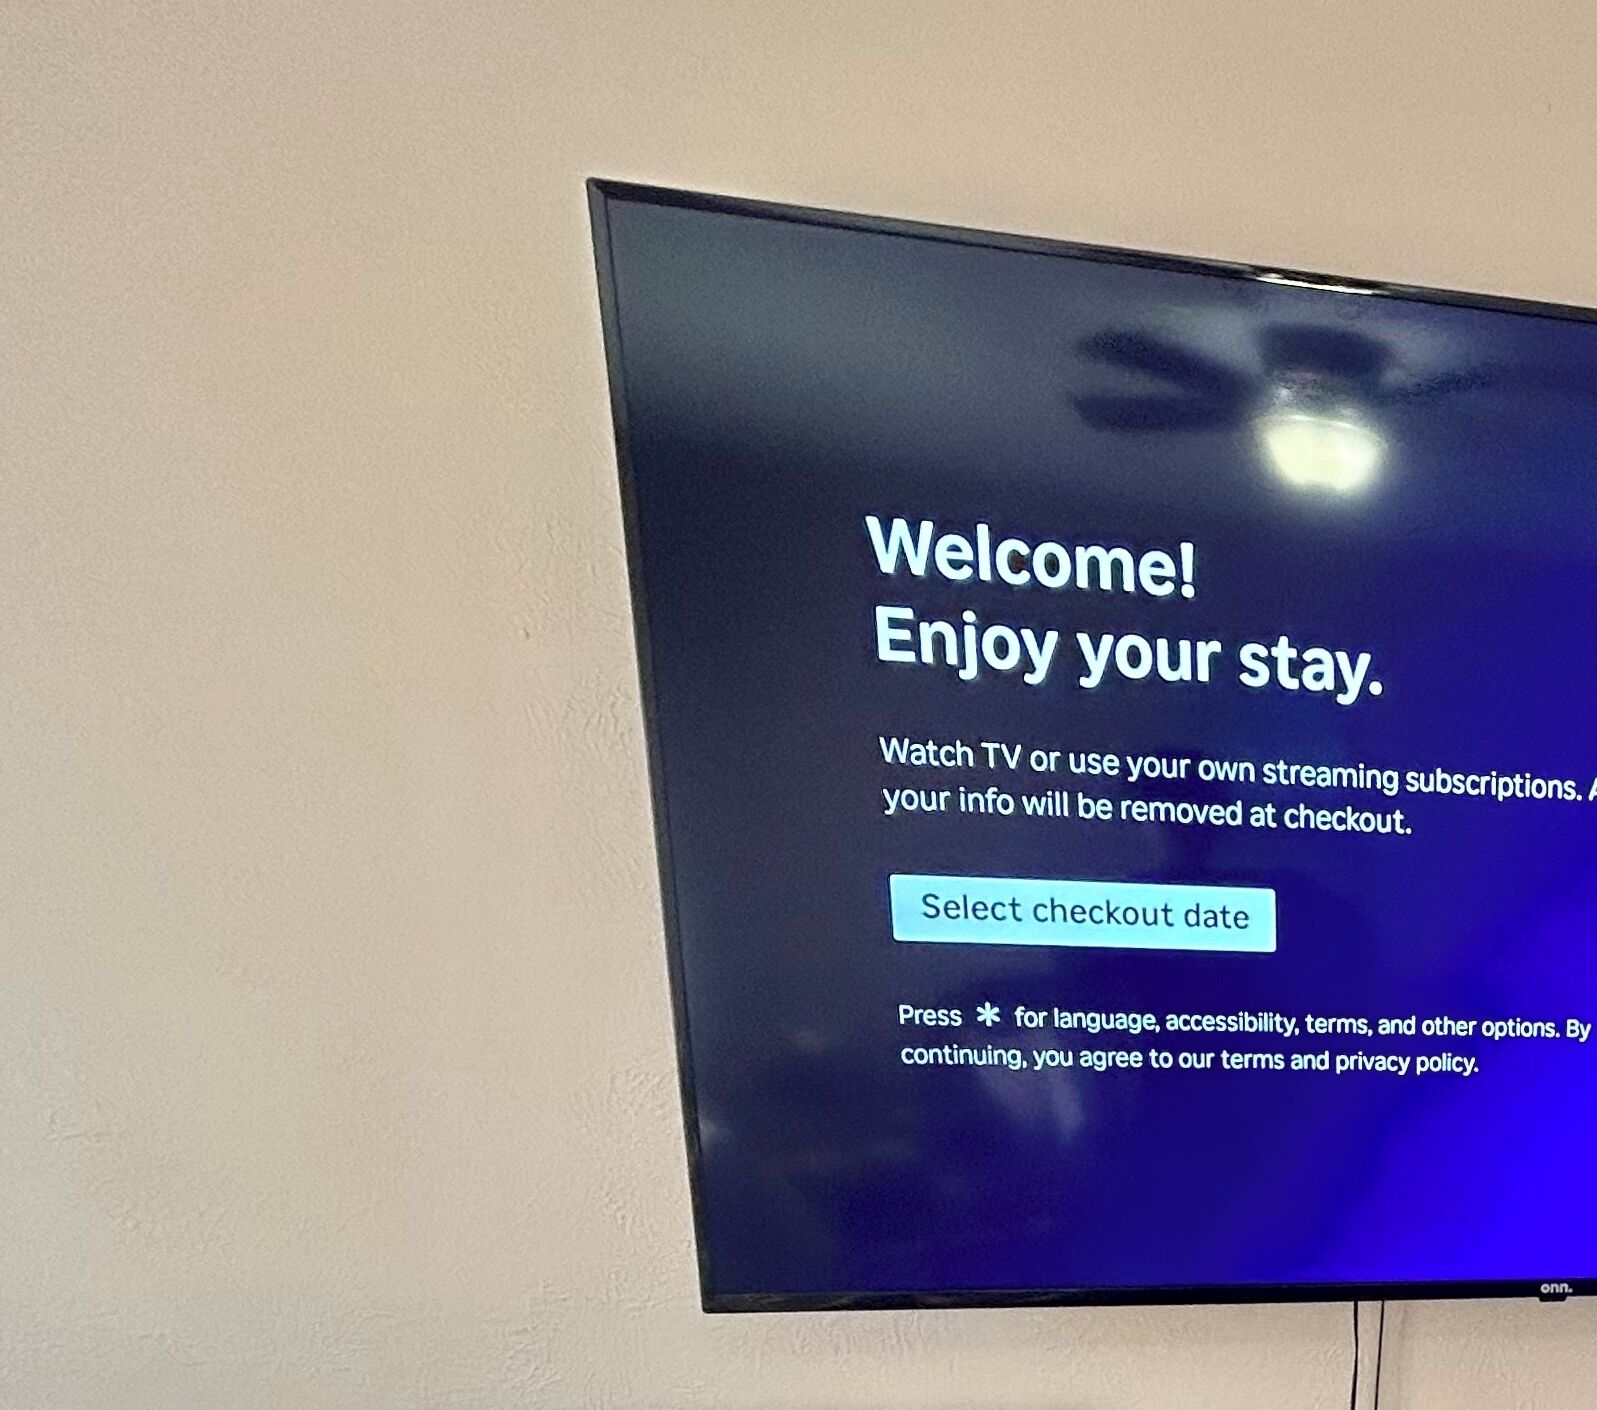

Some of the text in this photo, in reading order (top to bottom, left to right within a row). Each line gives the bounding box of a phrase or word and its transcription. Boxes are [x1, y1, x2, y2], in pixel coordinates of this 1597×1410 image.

[865, 514, 1199, 598] Welcome!
[874, 604, 1385, 707] Enjoy your stay.
[879, 737, 974, 771] Watch
[981, 743, 1022, 771] TV
[1029, 748, 1061, 774] or
[1069, 749, 1120, 777] use
[1127, 754, 1191, 784] your
[1199, 757, 1256, 783] own
[1263, 758, 1399, 796] streaming
[1405, 766, 1583, 803] subscriptions.
[882, 786, 1413, 835] your info will be removed at checkout.
[920, 892, 1251, 932] Select checkout date
[898, 1003, 1592, 1043] Press for language, accessibility, terms, and other options. By
[900, 1044, 1480, 1077] continuing, you agree to our terms and privacy policy.
